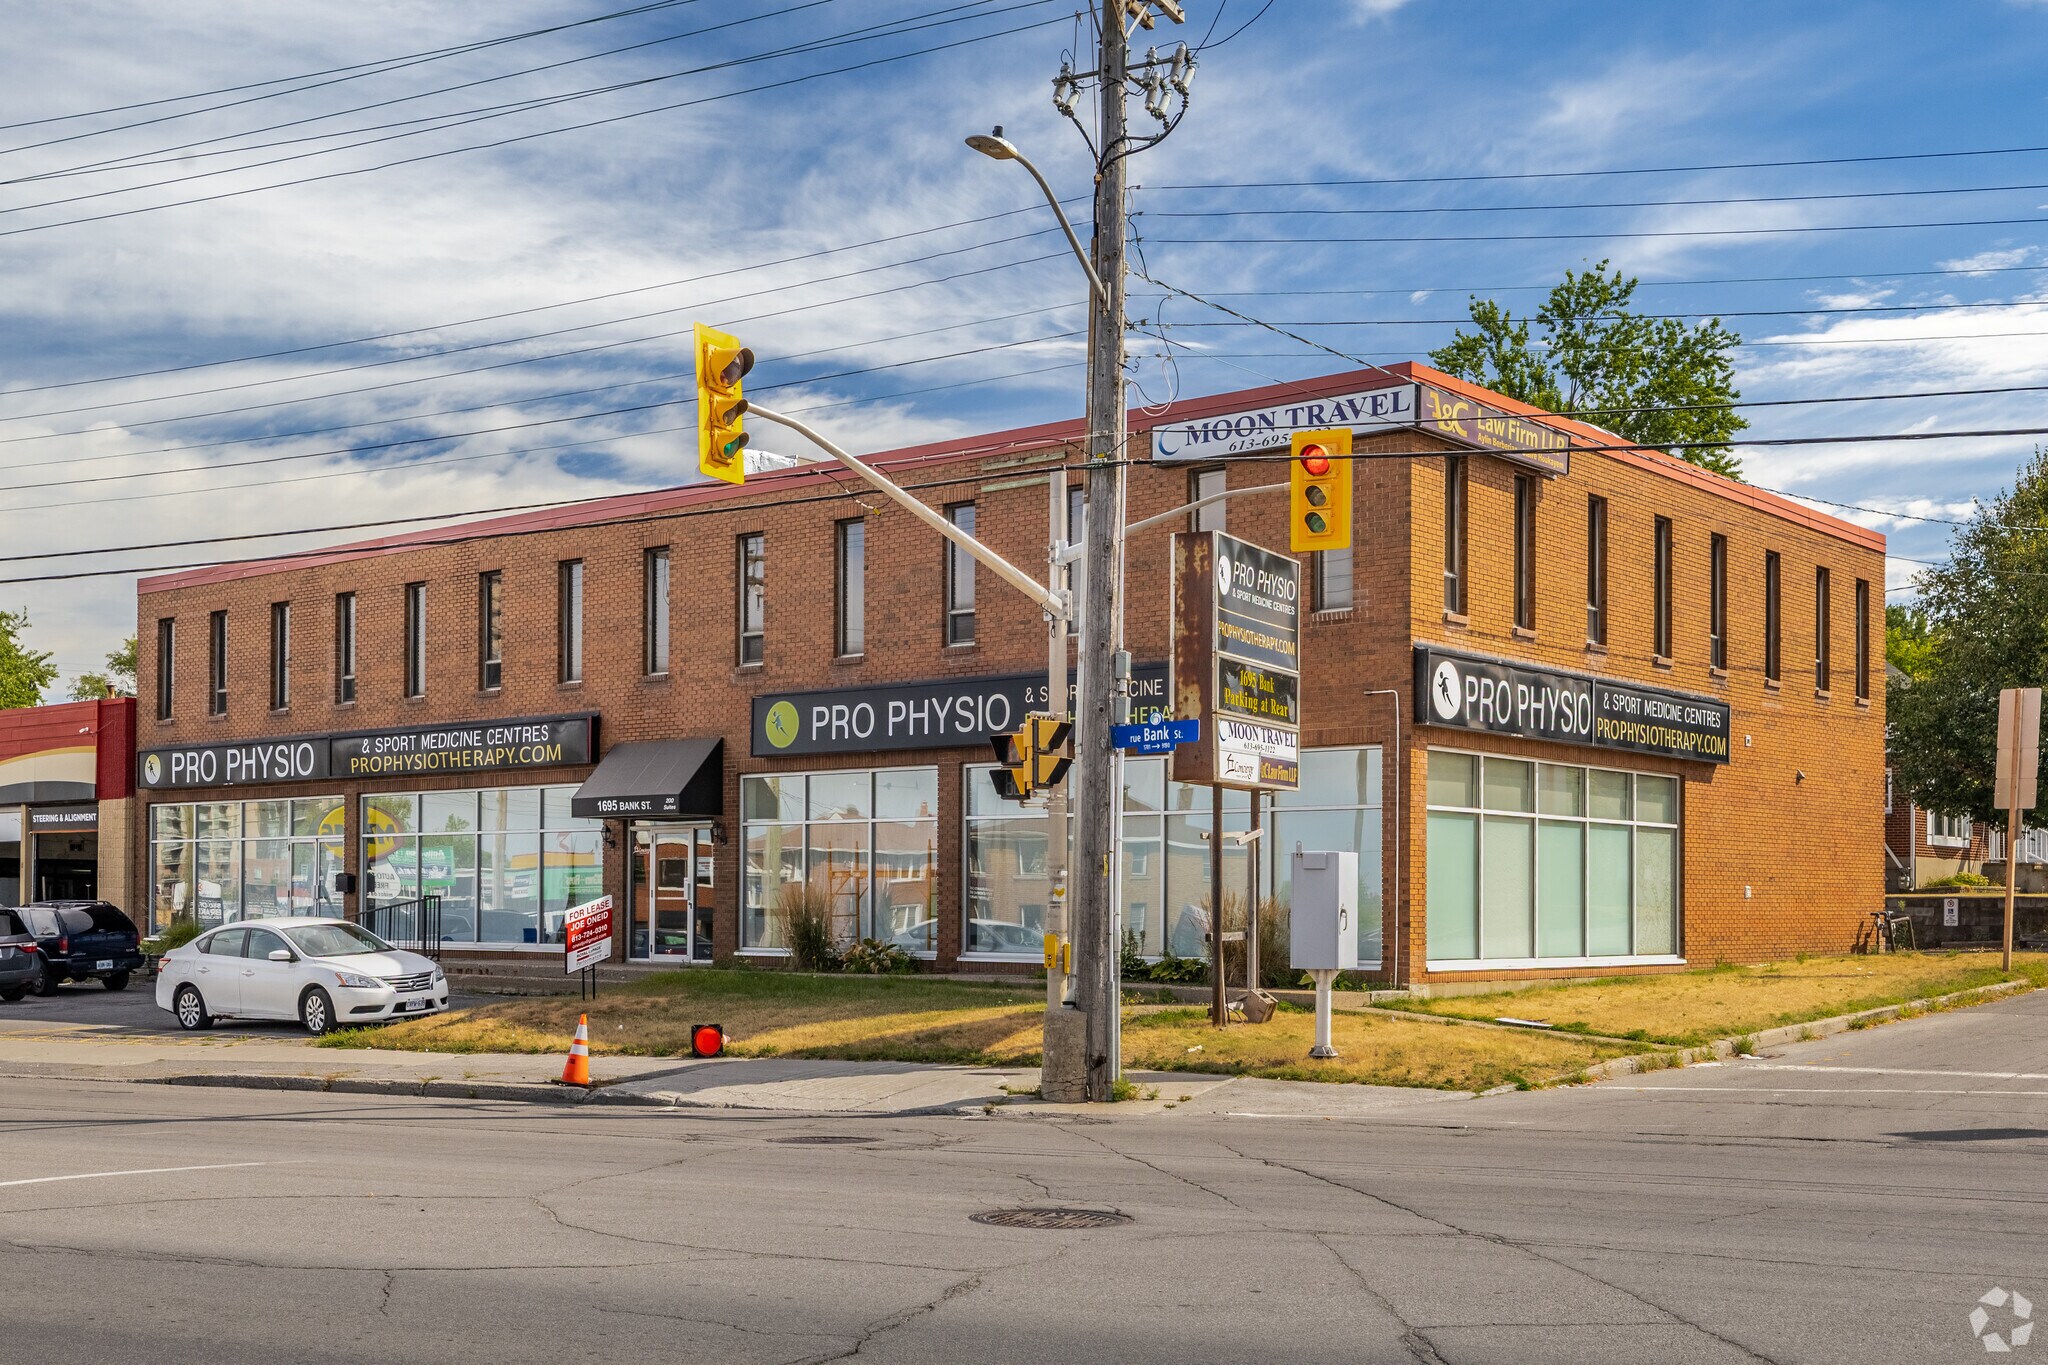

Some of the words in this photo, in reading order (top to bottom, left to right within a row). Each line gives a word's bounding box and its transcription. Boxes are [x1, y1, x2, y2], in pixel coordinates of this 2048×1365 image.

[1185, 410, 1278, 447] MOON
[1285, 390, 1411, 427] TRAVEL
[1477, 407, 1505, 438] Law
[1508, 419, 1538, 451] Firm
[1541, 430, 1566, 457] LLP
[1233, 561, 1255, 588] PRO
[1257, 569, 1296, 601] PHYSIO
[1232, 587, 1236, 597] &
[1236, 589, 1251, 602] SPORT
[1251, 595, 1273, 610] MEDICINE
[1273, 601, 1295, 615] CENTRES
[1218, 620, 1295, 656] PROPHYSIOTHERAPY.COM
[1025, 687, 1034, 703] &
[1240, 669, 1257, 688] 1695
[1259, 674, 1275, 693] Bank
[1224, 687, 1259, 713] Parking
[1260, 697, 1268, 712] at
[1270, 700, 1288, 717] Rear
[1465, 675, 1511, 725] PRO
[1517, 684, 1590, 735] PHYSIO
[1603, 692, 1610, 710] &
[1612, 694, 1642, 714] SPORT
[1644, 699, 1682, 723] MEDICINE
[1684, 705, 1721, 729] CENTRES
[812, 702, 875, 741] PRO
[888, 693, 1011, 737] PHYSIO
[362, 738, 370, 753] &
[375, 735, 416, 752] SPORT
[421, 730, 482, 750] MEDICINE
[487, 724, 549, 745] CENTRES
[1130, 735, 1141, 743] rue
[1143, 726, 1170, 742] Bank
[1174, 730, 1184, 739] St.
[1228, 721, 1259, 742] MOON
[1261, 727, 1296, 748] TRAVEL
[1243, 742, 1276, 754] 613-695-1122
[1597, 718, 1727, 756] PROPHYSIOTHERAPY.COM
[171, 750, 217, 783] PRO
[226, 743, 315, 780] PHYSIO
[351, 743, 562, 774] PROPHYSIOTHERAPY.COM
[32, 815, 59, 823] STEERING
[59, 814, 64, 822] &
[64, 813, 97, 822] ALIGNMENT
[597, 800, 617, 811] 1695
[619, 802, 640, 811] BANK
[641, 801, 652, 810] ST.
[569, 909, 585, 921] FOR
[586, 899, 610, 915] LEASE
[570, 920, 585, 932] JOE
[586, 911, 609, 924] ONEID
[571, 924, 608, 943] 613-724-0310
